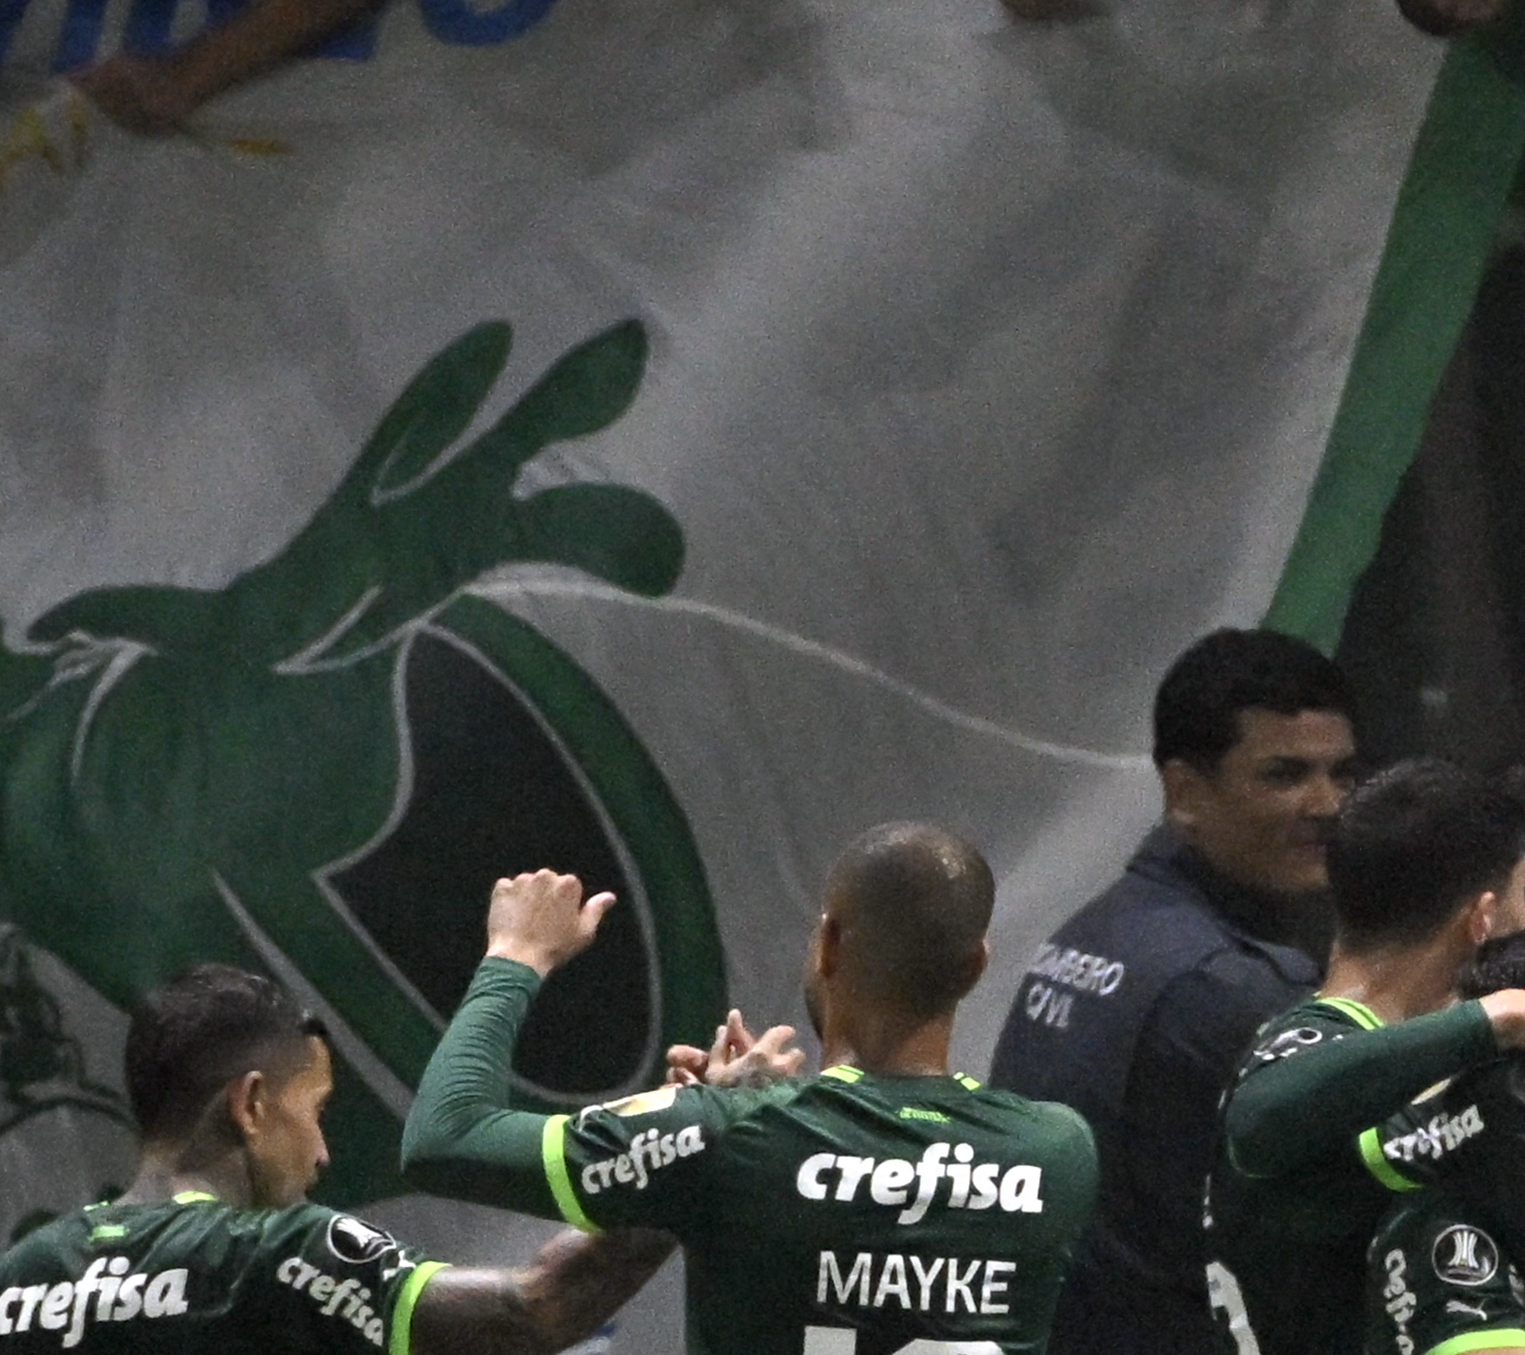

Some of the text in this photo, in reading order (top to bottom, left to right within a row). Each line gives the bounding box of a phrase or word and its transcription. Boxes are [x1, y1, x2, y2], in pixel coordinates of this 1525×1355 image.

[581, 1123, 707, 1196] crefisa
[796, 1142, 1045, 1226] crefisa
[816, 1250, 1018, 1314] MAYKE
